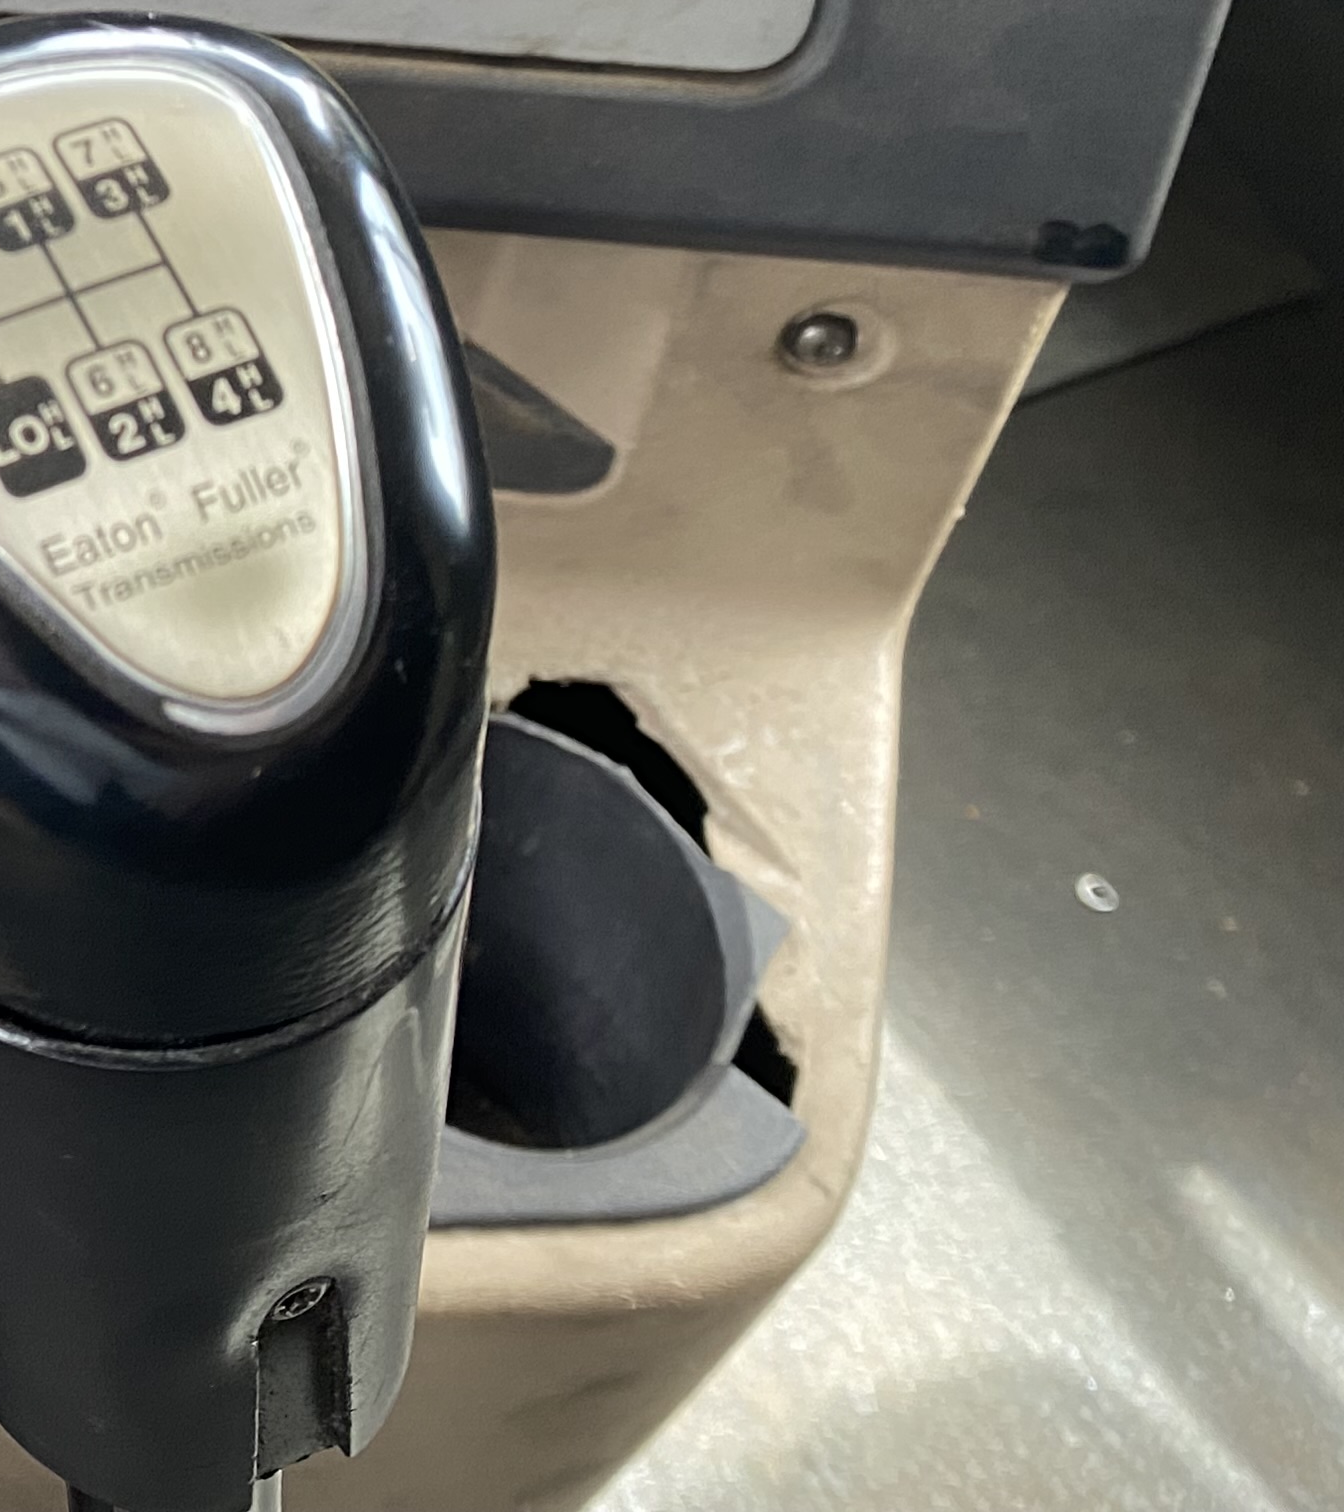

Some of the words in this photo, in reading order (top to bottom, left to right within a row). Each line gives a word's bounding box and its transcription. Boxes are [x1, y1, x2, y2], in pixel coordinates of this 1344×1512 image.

[72, 138, 96, 167] 7
[94, 178, 130, 213] 3
[2, 209, 32, 243] 1
[185, 331, 212, 364] 8
[87, 363, 115, 397] 6
[235, 361, 263, 390] H
[37, 398, 64, 426] H
[137, 395, 165, 424] H
[211, 376, 242, 417] 4
[247, 387, 274, 412] L
[48, 424, 75, 452] L
[107, 412, 148, 455] 2
[148, 421, 176, 446] L
[70, 508, 317, 612] Transmissions
